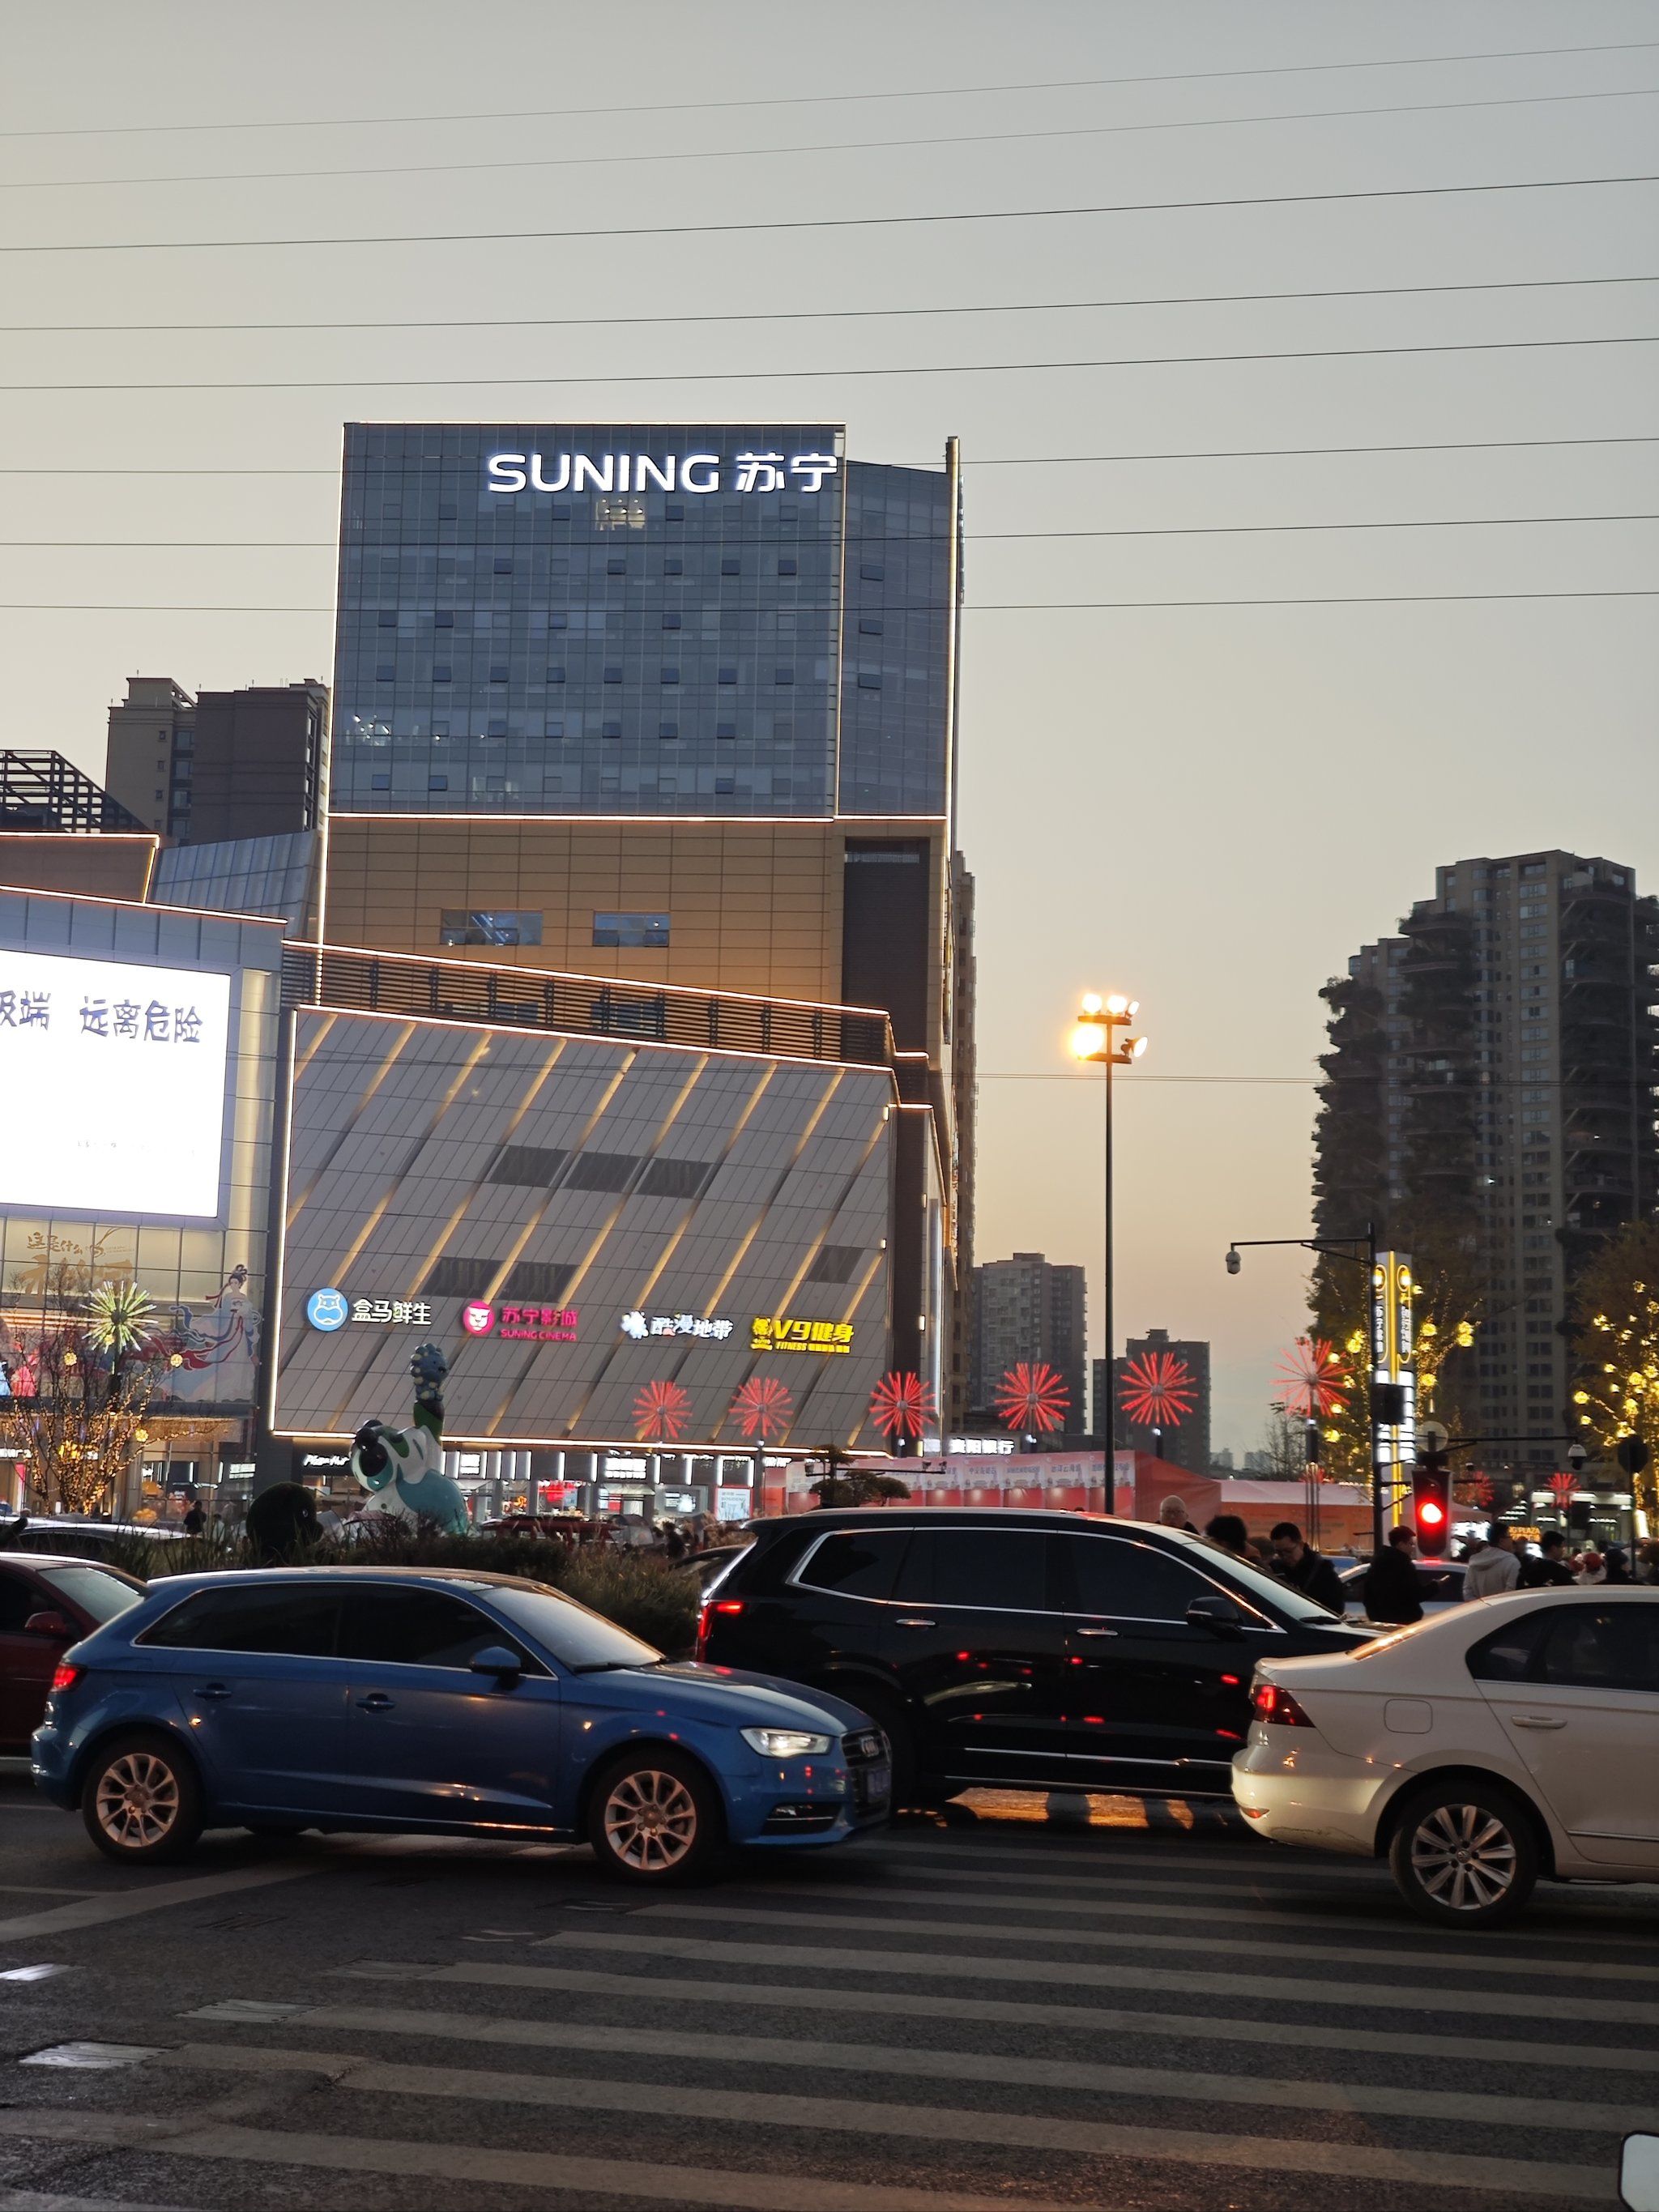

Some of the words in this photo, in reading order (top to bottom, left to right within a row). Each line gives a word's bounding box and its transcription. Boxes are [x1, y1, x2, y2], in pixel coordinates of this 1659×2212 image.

[488, 454, 719, 493] SUNING
[736, 452, 838, 493] 苏宁
[79, 996, 203, 1043] 远离危险
[352, 1298, 432, 1326] 盒马鲜生
[501, 1306, 578, 1328] 苏宁影城
[501, 1329, 538, 1340] SUNING
[539, 1331, 578, 1341] CINEMA
[650, 1314, 733, 1340] 酷漫地带
[774, 1319, 854, 1343] V9健身
[775, 1341, 808, 1351] FITNESS
